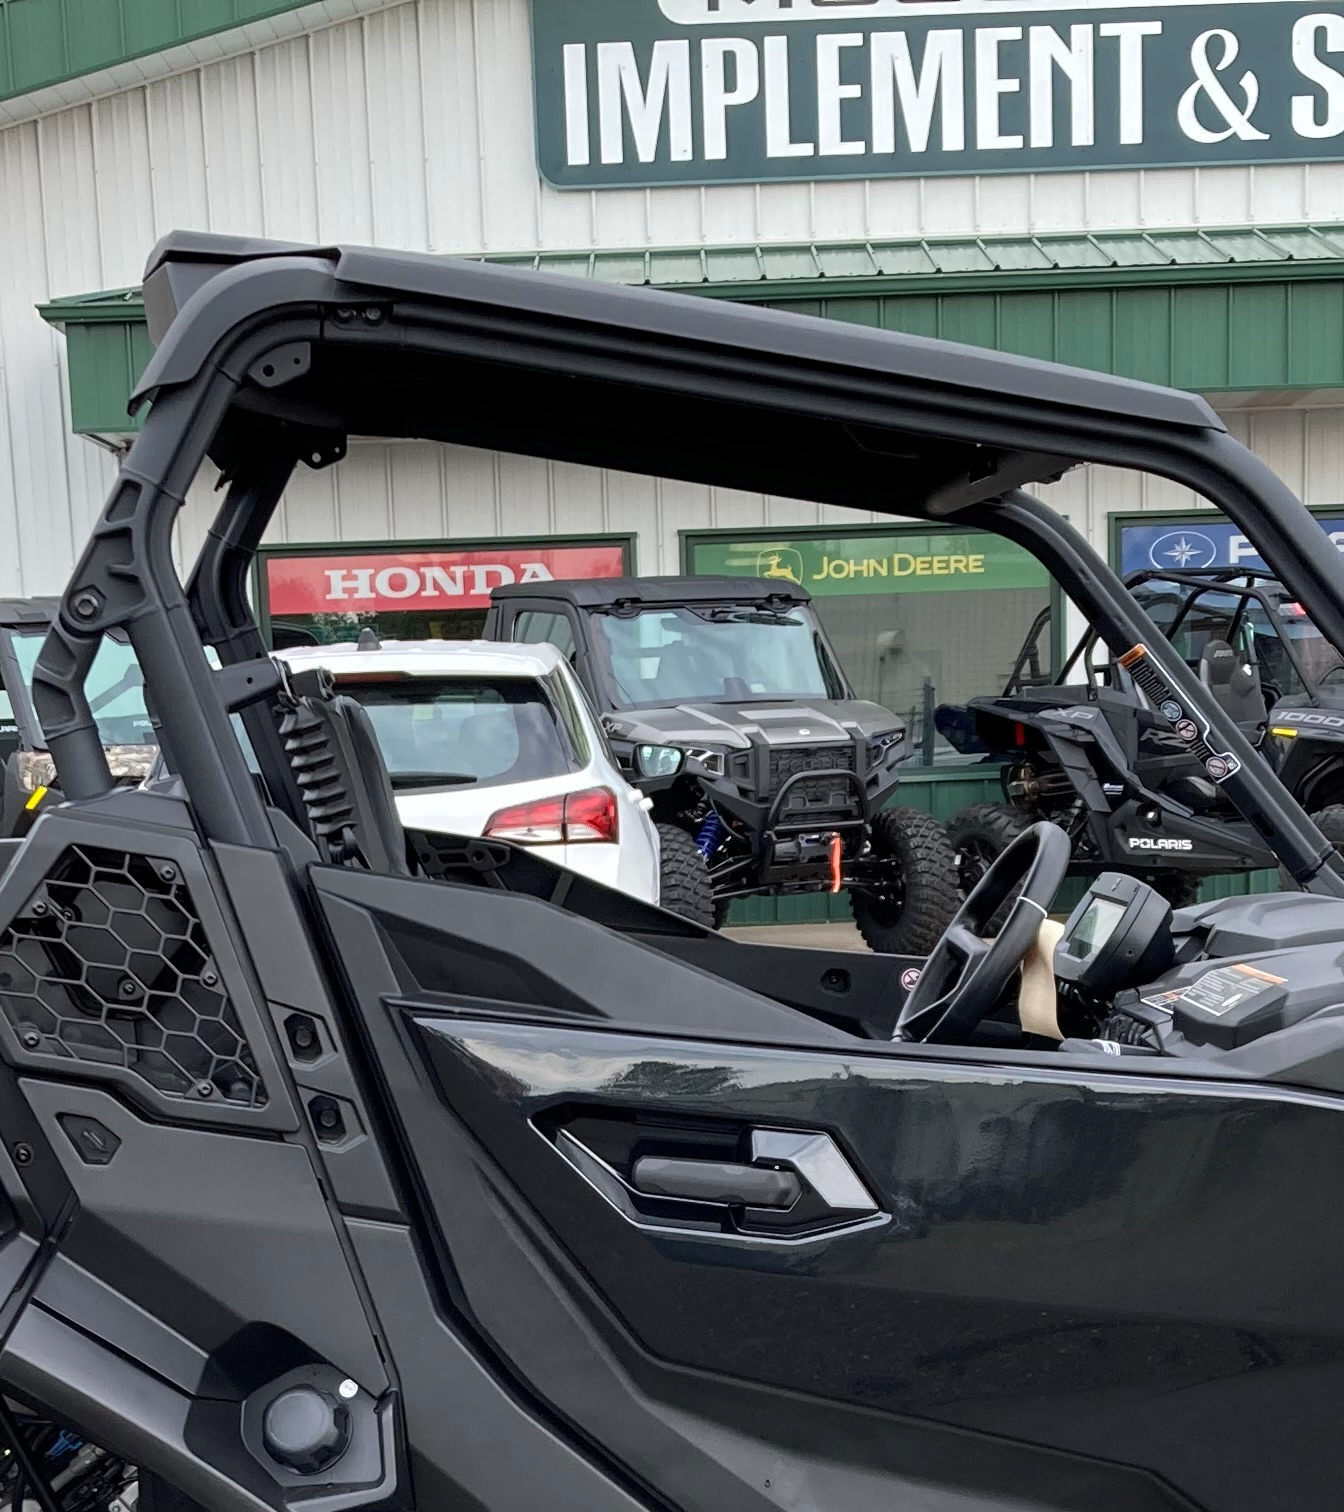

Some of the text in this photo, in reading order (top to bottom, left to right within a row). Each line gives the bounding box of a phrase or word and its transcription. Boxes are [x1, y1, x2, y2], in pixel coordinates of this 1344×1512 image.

[563, 20, 1160, 166] IMPLEMENT
[1177, 28, 1270, 143] &
[813, 553, 985, 580] JOHN DEERE
[1129, 838, 1193, 850] POLARIS
